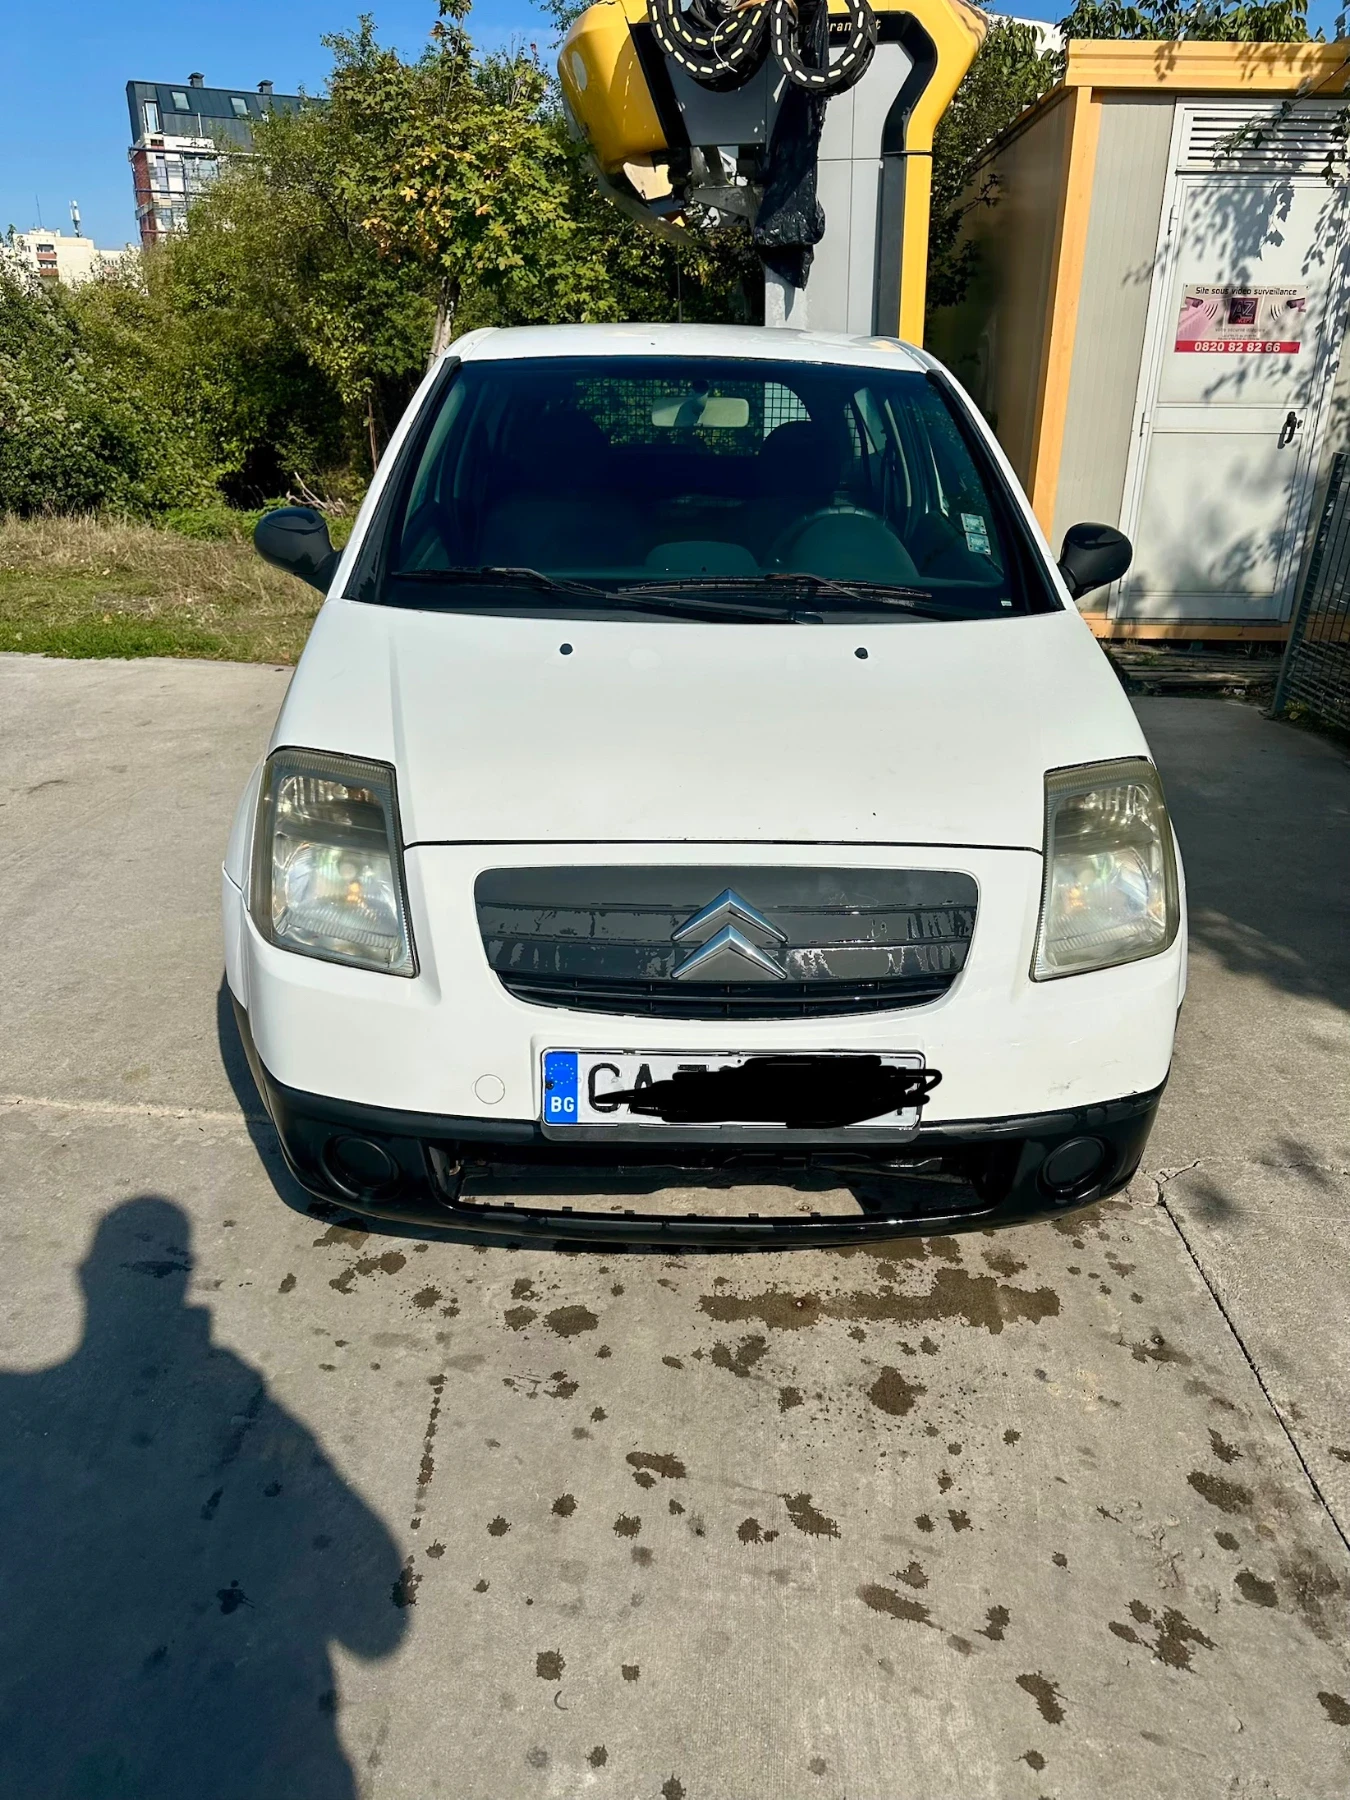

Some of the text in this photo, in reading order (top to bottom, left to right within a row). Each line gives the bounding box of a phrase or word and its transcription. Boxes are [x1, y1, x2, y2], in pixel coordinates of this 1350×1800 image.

[1195, 287, 1209, 295] Site
[1253, 287, 1298, 296] surveillance
[1232, 301, 1255, 318] AZ
[1194, 342, 1281, 353] 0820 82 82 66
[551, 1096, 575, 1113] BG
